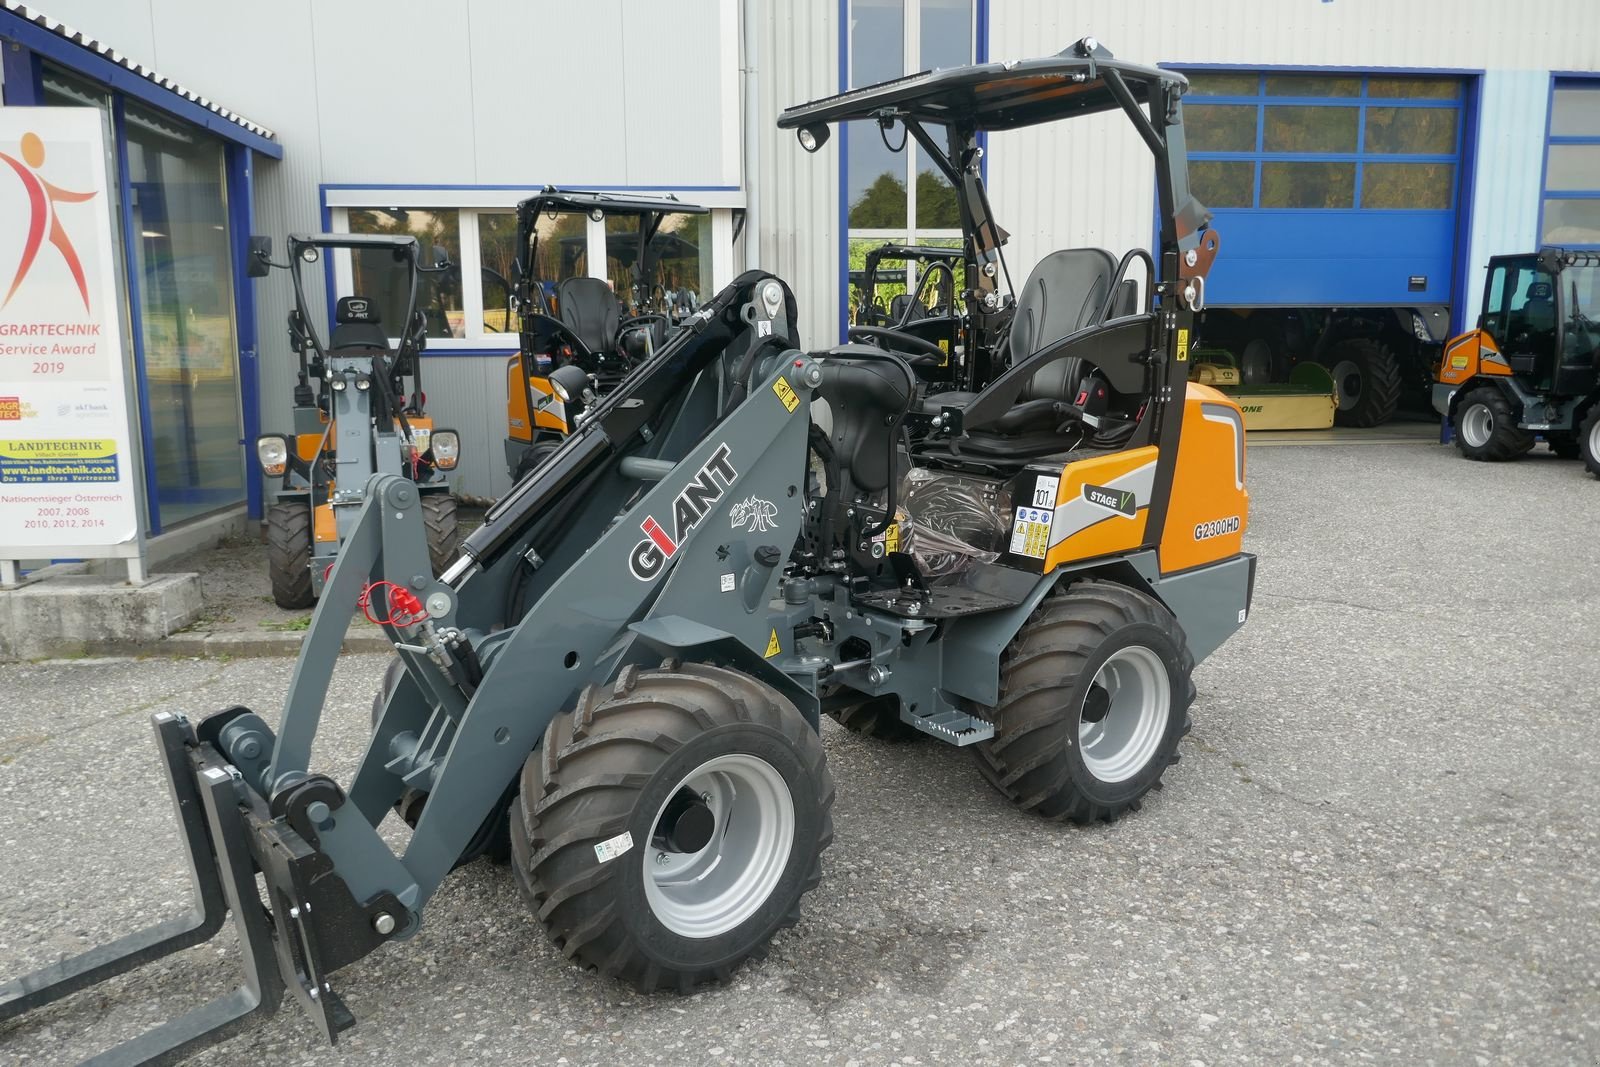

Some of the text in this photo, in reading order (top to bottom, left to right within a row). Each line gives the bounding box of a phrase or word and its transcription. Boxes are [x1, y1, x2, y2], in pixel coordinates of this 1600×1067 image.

[0, 342, 96, 355] Service Award
[32, 362, 65, 374] 2019
[1241, 405, 1264, 413] ONE
[9, 441, 103, 451] LANDTECHNIK
[2, 465, 116, 475] www.landtechnik.co.at
[1, 495, 72, 504] Nationensieger
[1035, 489, 1049, 506] 101
[1090, 491, 1118, 508] STAGE
[66, 508, 90, 516] 2008
[82, 519, 105, 528] 2014
[1194, 516, 1241, 541] G2300HD
